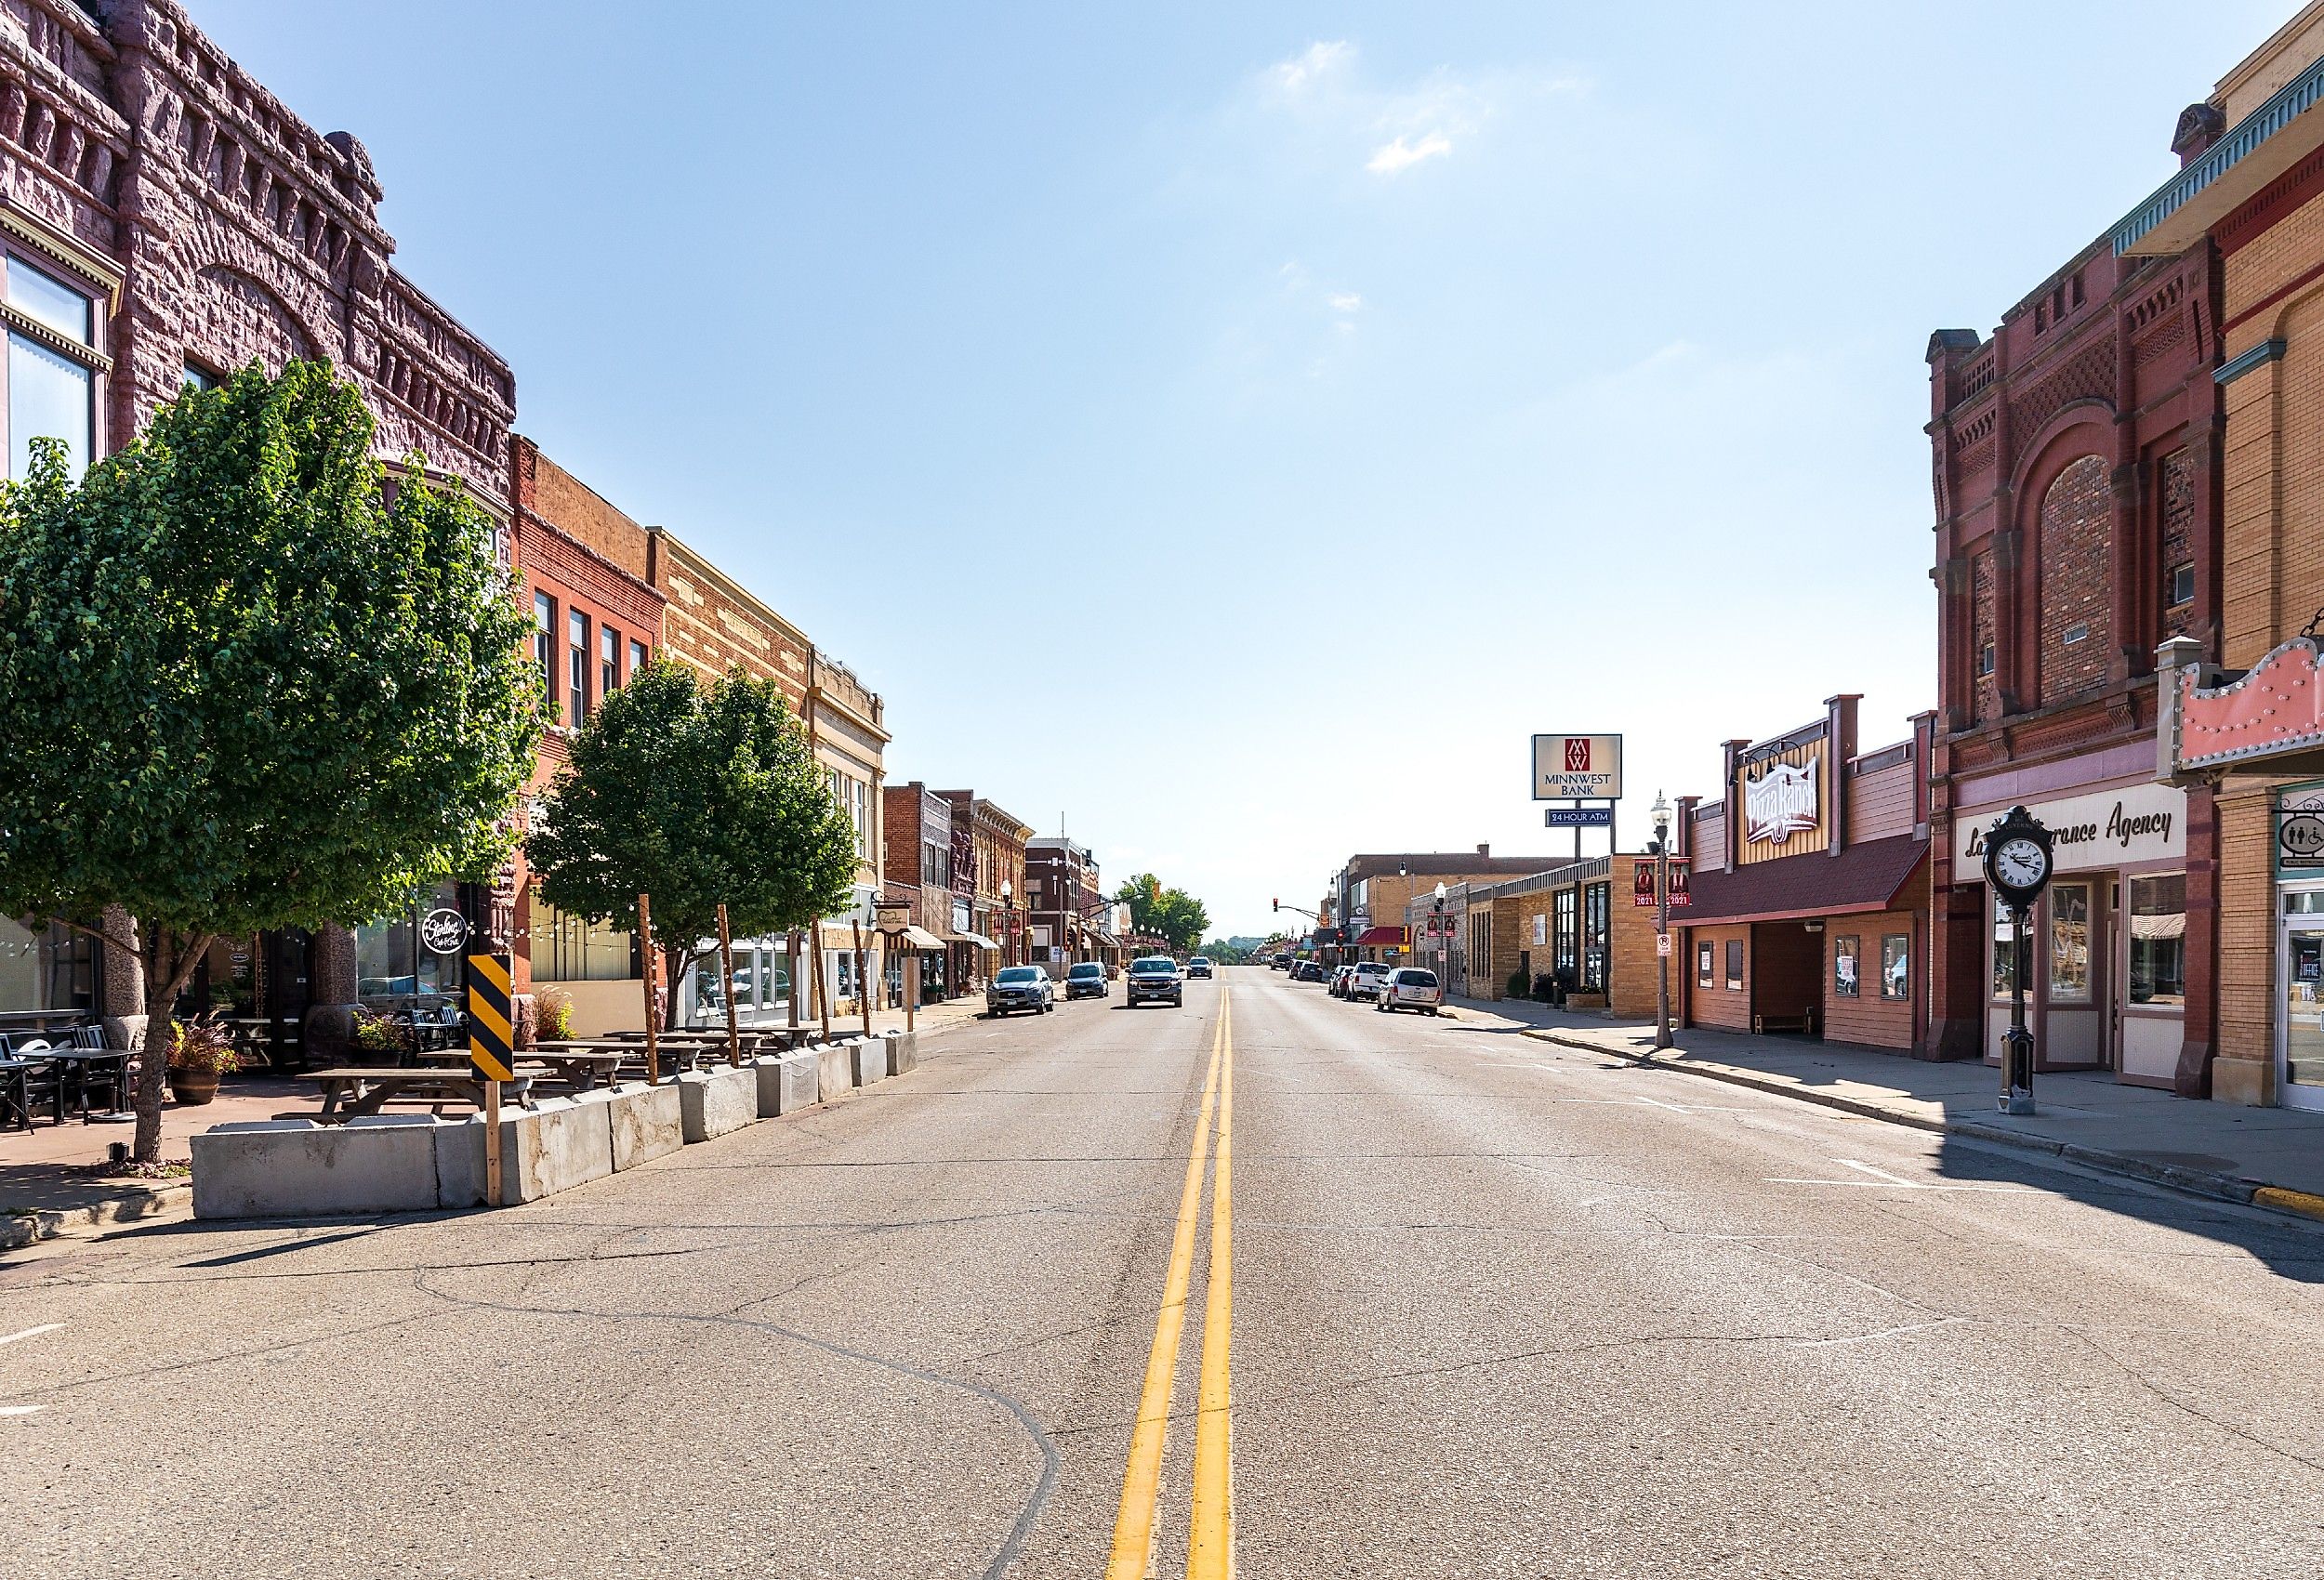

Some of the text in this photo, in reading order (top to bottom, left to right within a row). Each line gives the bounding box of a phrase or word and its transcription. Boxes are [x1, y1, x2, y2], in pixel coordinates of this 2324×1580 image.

[1545, 774, 1611, 784] MINNWEST
[1562, 785, 1594, 796] BANK
[1748, 769, 1816, 834] Pizza Ranch
[2053, 823, 2097, 845] rance
[2106, 801, 2172, 848] Agency
[1637, 896, 1687, 905] 2021 2021
